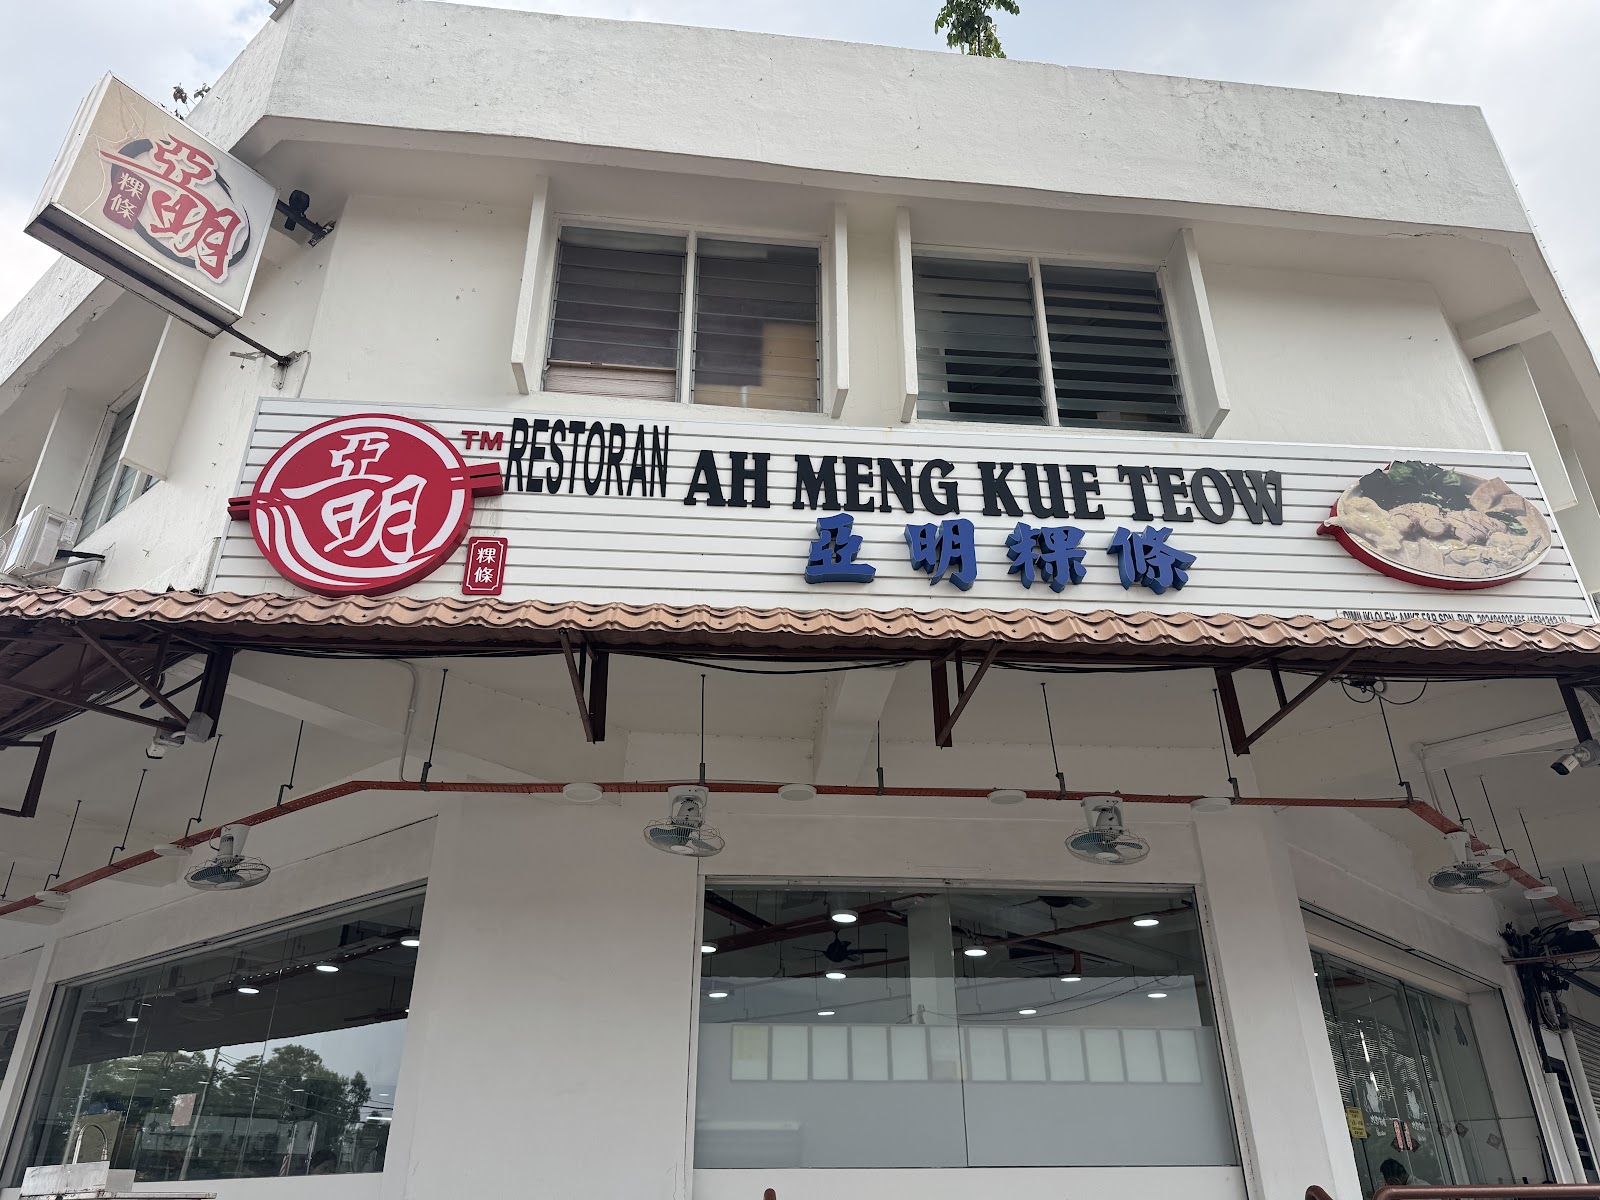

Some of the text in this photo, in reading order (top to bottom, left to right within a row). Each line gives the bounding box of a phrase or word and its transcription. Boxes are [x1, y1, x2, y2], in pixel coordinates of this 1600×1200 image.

[461, 430, 504, 451] TM
[504, 417, 1283, 525] RESTORAN AH MENG KUE TEOW
[280, 431, 428, 564] 亞明
[474, 547, 497, 584] 粿條
